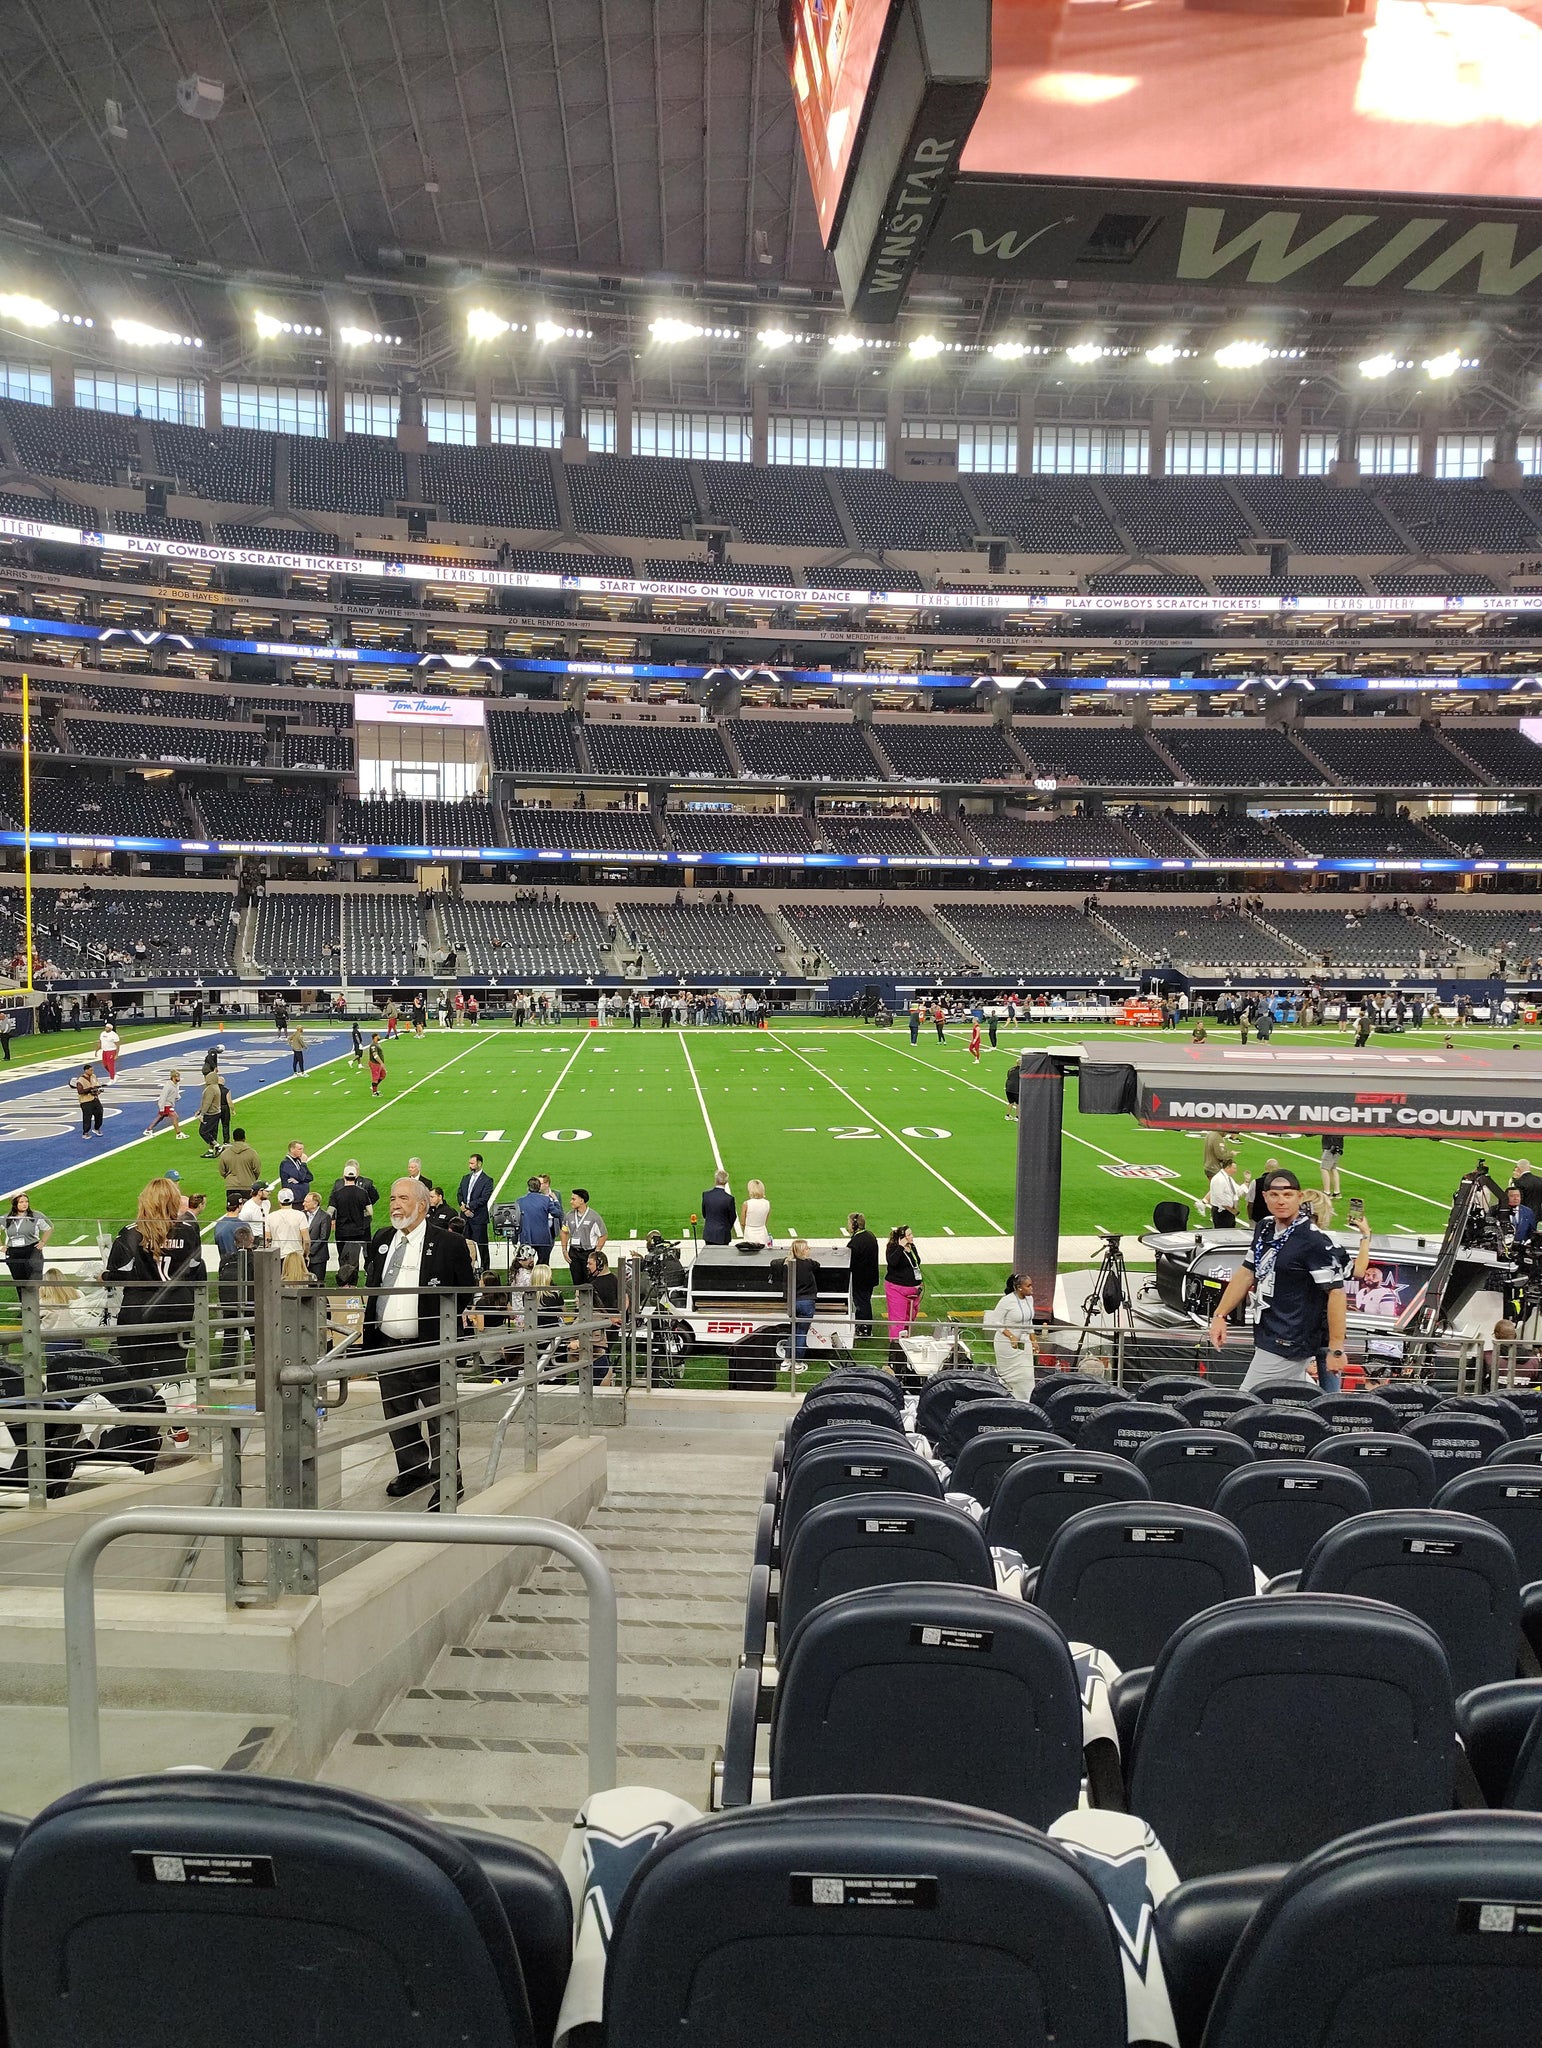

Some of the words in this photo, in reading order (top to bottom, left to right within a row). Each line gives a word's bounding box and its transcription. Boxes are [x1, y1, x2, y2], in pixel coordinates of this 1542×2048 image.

[868, 137, 955, 294] WINSTAR
[128, 539, 161, 554] PLAY
[166, 544, 236, 561] COWBOYS
[240, 552, 301, 567] SCRATCH
[305, 558, 362, 572] TICKETS!
[435, 568, 475, 582] TEXAS
[481, 572, 530, 585] LOTTERY
[600, 580, 636, 591] START
[639, 582, 697, 595] WORKING
[701, 586, 719, 596] ON
[723, 587, 754, 598] YOUR
[758, 589, 807, 600] VICTORY
[812, 591, 850, 601] DANCE
[192, 592, 220, 602] HAYES
[914, 594, 950, 605] TEXAS
[956, 596, 1000, 606] LOTTERY
[1065, 599, 1092, 608] PLAY
[1096, 599, 1153, 608] COWBOYS
[1157, 599, 1208, 609] SCRATCH
[1212, 599, 1261, 609] TICKETS!
[1327, 599, 1363, 609] TEXAS
[1369, 599, 1415, 609] LOTTERY
[1483, 599, 1519, 608] START
[347, 606, 373, 614] RANDY
[376, 607, 401, 616] WHITE
[537, 619, 565, 627] RENFRO
[389, 699, 414, 711] Tom
[411, 699, 450, 712] Thumb
[1355, 1092, 1407, 1105] ESPN
[1169, 1101, 1295, 1121] MONDAY
[1299, 1105, 1392, 1124] NIGHT
[1396, 1107, 1542, 1129] COUNTDO
[707, 1321, 754, 1334] ESPN
[1258, 1431, 1305, 1442] RESERVED
[1253, 1441, 1278, 1450] FIELD
[1279, 1443, 1306, 1453] SUITE
[1432, 1439, 1480, 1447] RESERVED
[1455, 1450, 1482, 1459] SUITE
